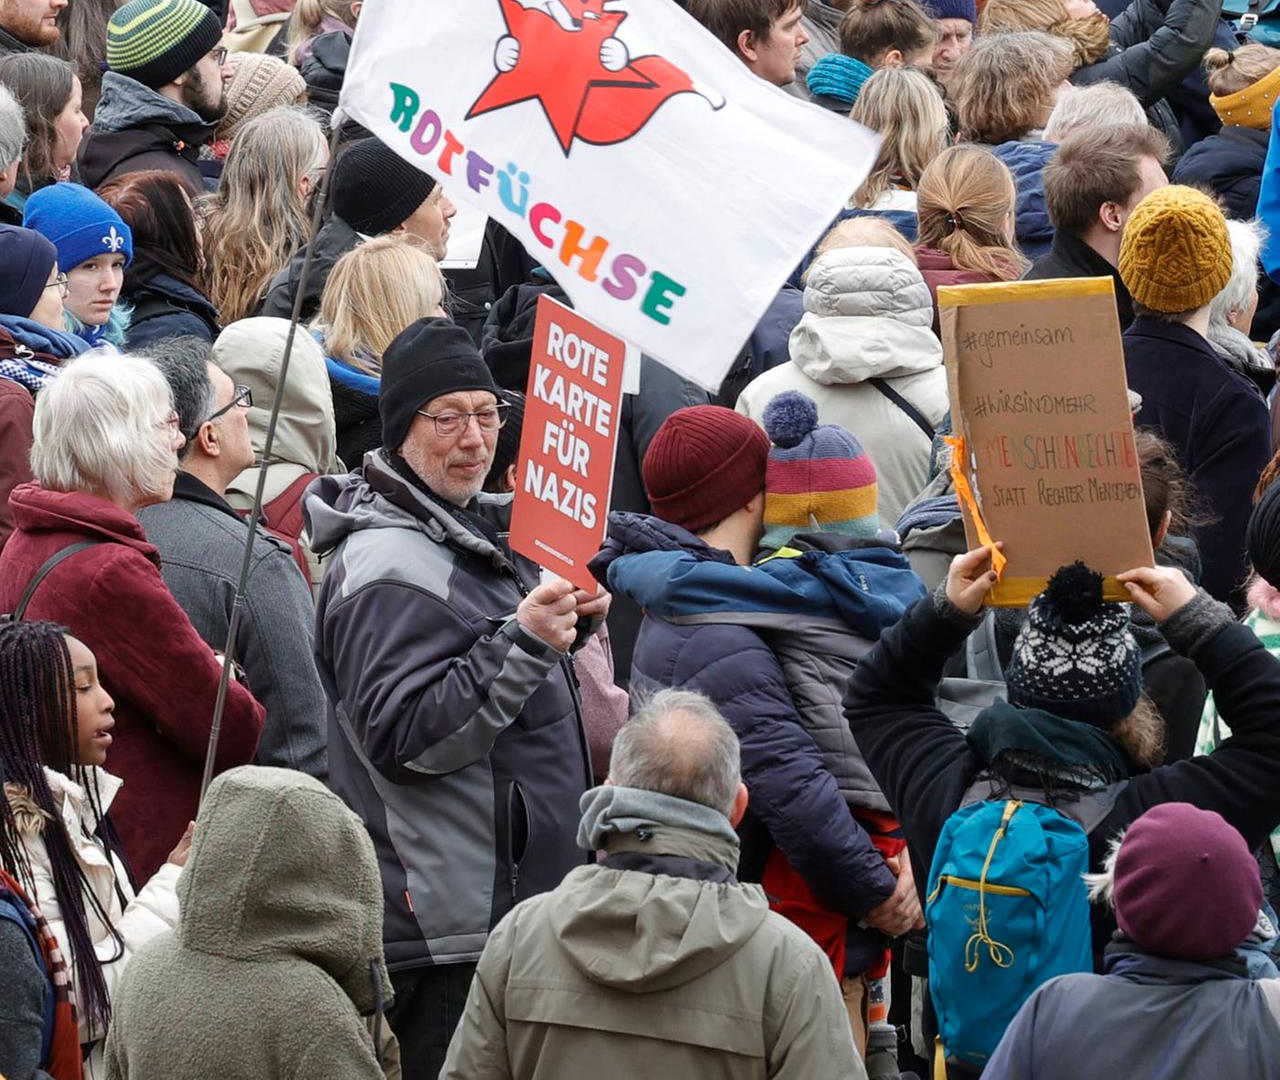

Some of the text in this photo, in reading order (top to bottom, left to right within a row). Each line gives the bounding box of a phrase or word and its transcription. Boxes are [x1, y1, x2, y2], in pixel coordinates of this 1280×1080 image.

[389, 81, 687, 326] ROTFÜCHSE
[546, 321, 611, 388] ROTE
[963, 323, 1075, 369] #gemeinsam
[532, 363, 613, 438] KARTE
[542, 419, 591, 479] FÜR
[524, 459, 598, 530] NAZIS
